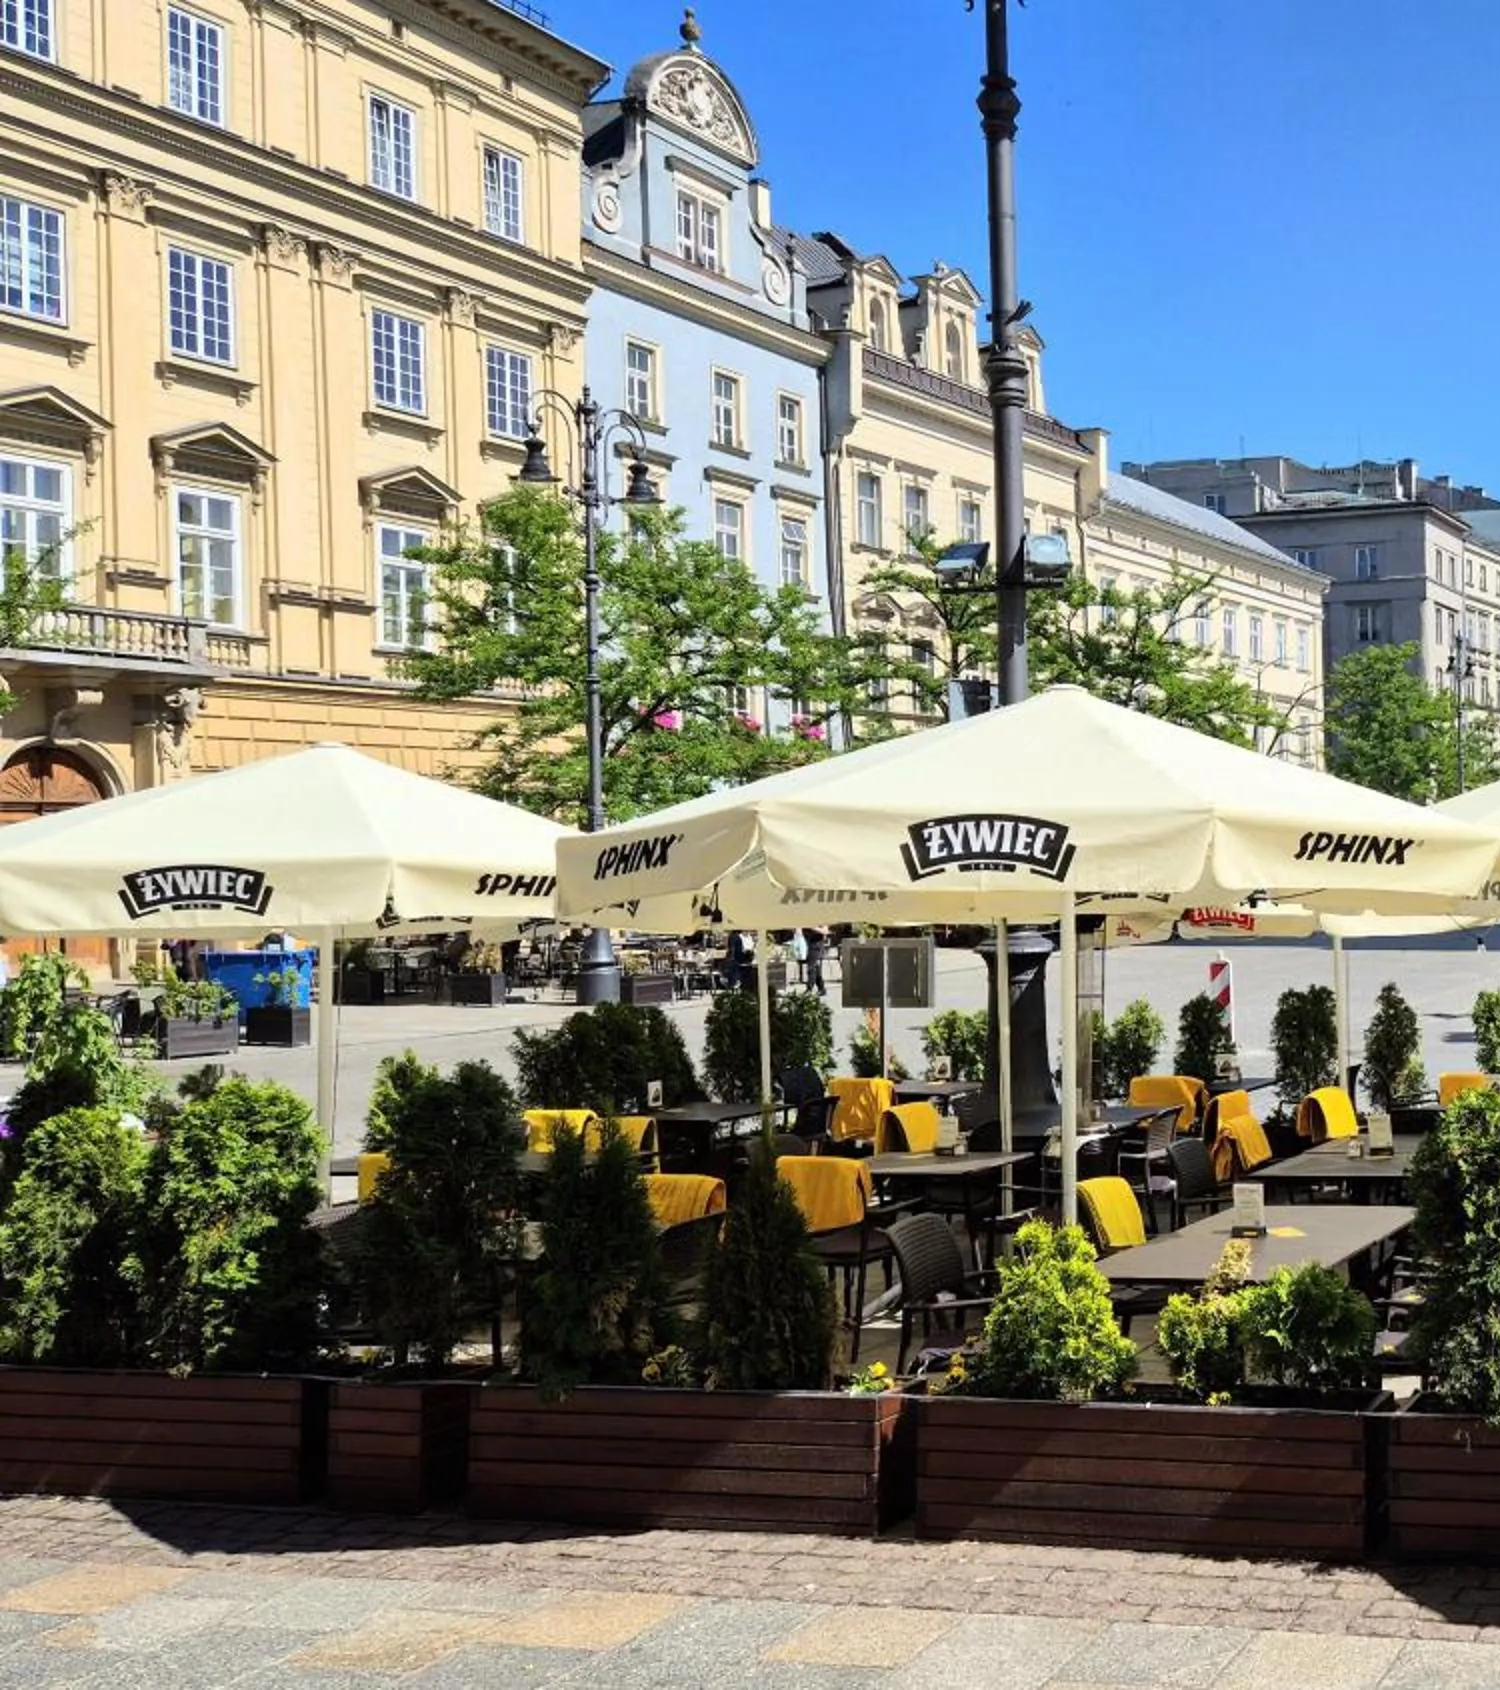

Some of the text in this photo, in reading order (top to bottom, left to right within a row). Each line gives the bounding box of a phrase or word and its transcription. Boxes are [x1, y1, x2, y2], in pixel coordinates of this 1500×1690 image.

[922, 820, 1057, 860] ŻYWIEC
[136, 869, 255, 902] ŻYWIEC
[474, 873, 557, 897] SPHI
